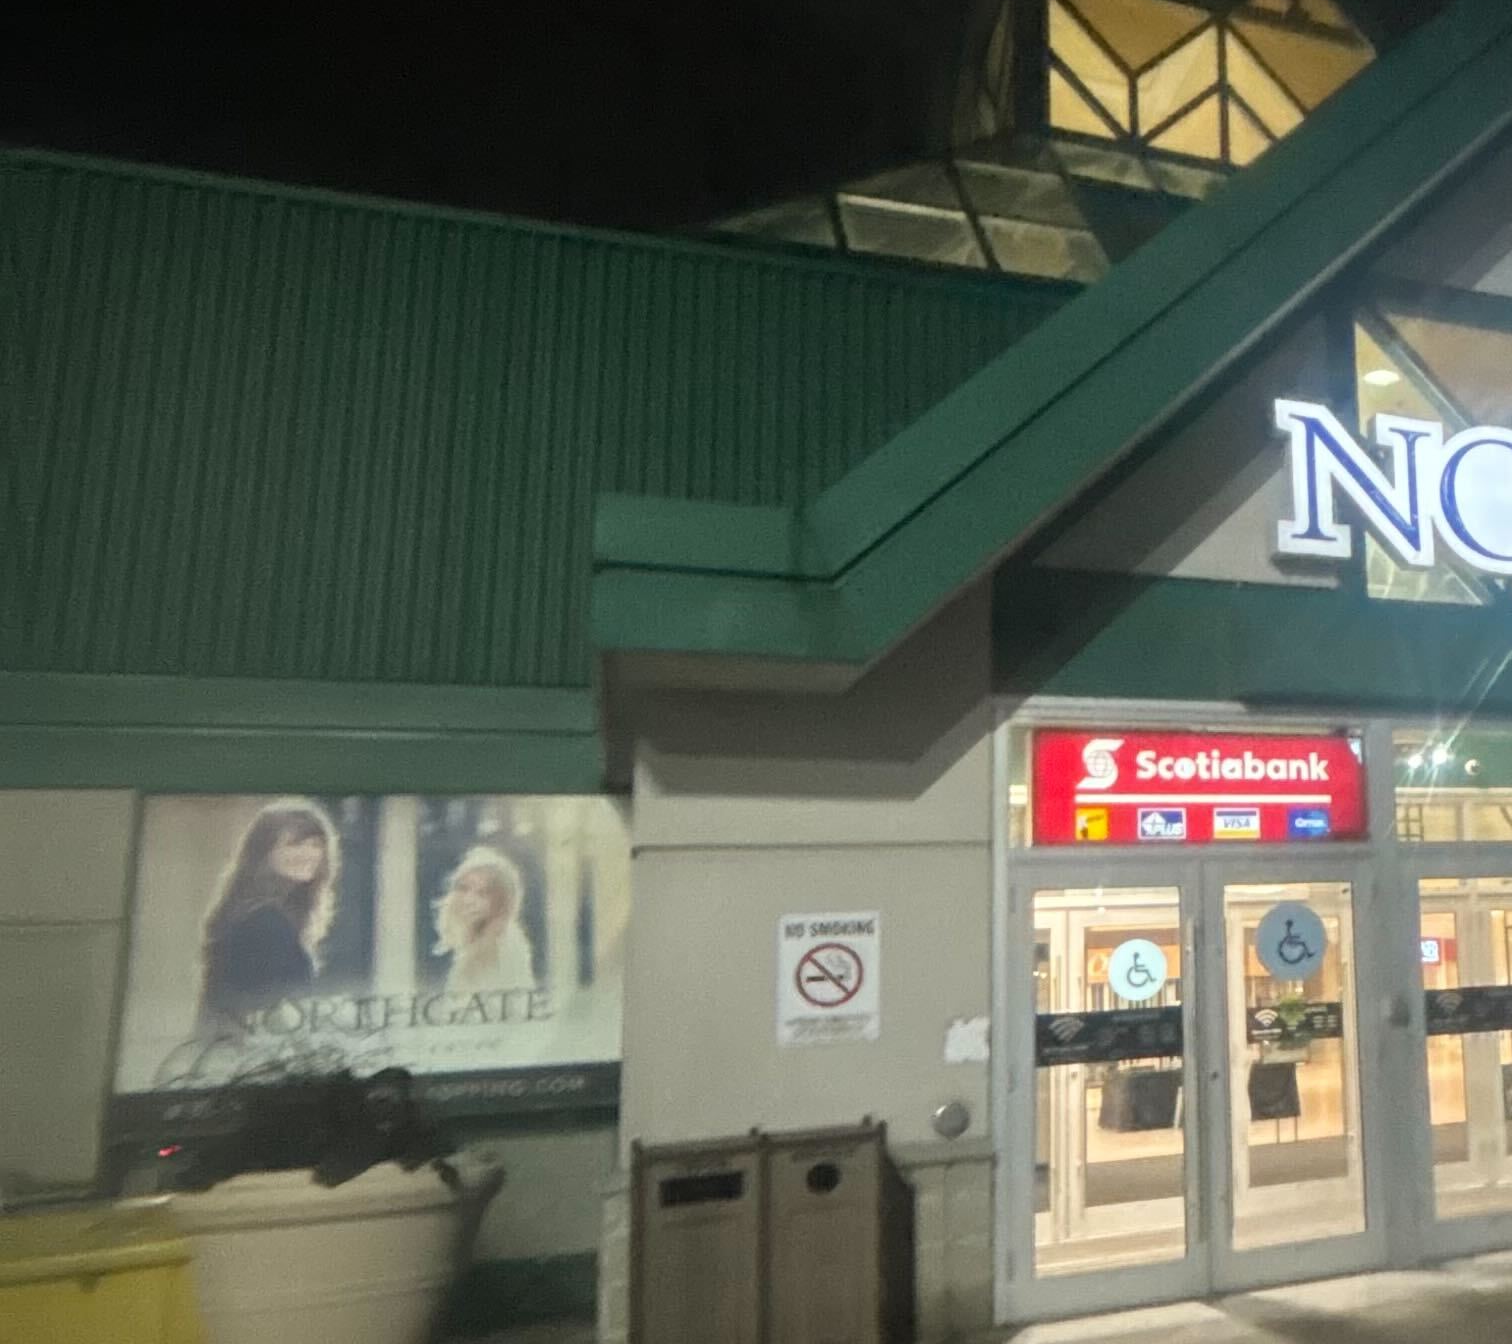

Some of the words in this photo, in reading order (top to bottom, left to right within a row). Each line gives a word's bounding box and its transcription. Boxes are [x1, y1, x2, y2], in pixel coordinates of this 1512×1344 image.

[1136, 750, 1329, 781] Scotiabank
[1223, 817, 1251, 829] VISA
[785, 923, 804, 938] NO
[810, 920, 875, 936] SMOKING
